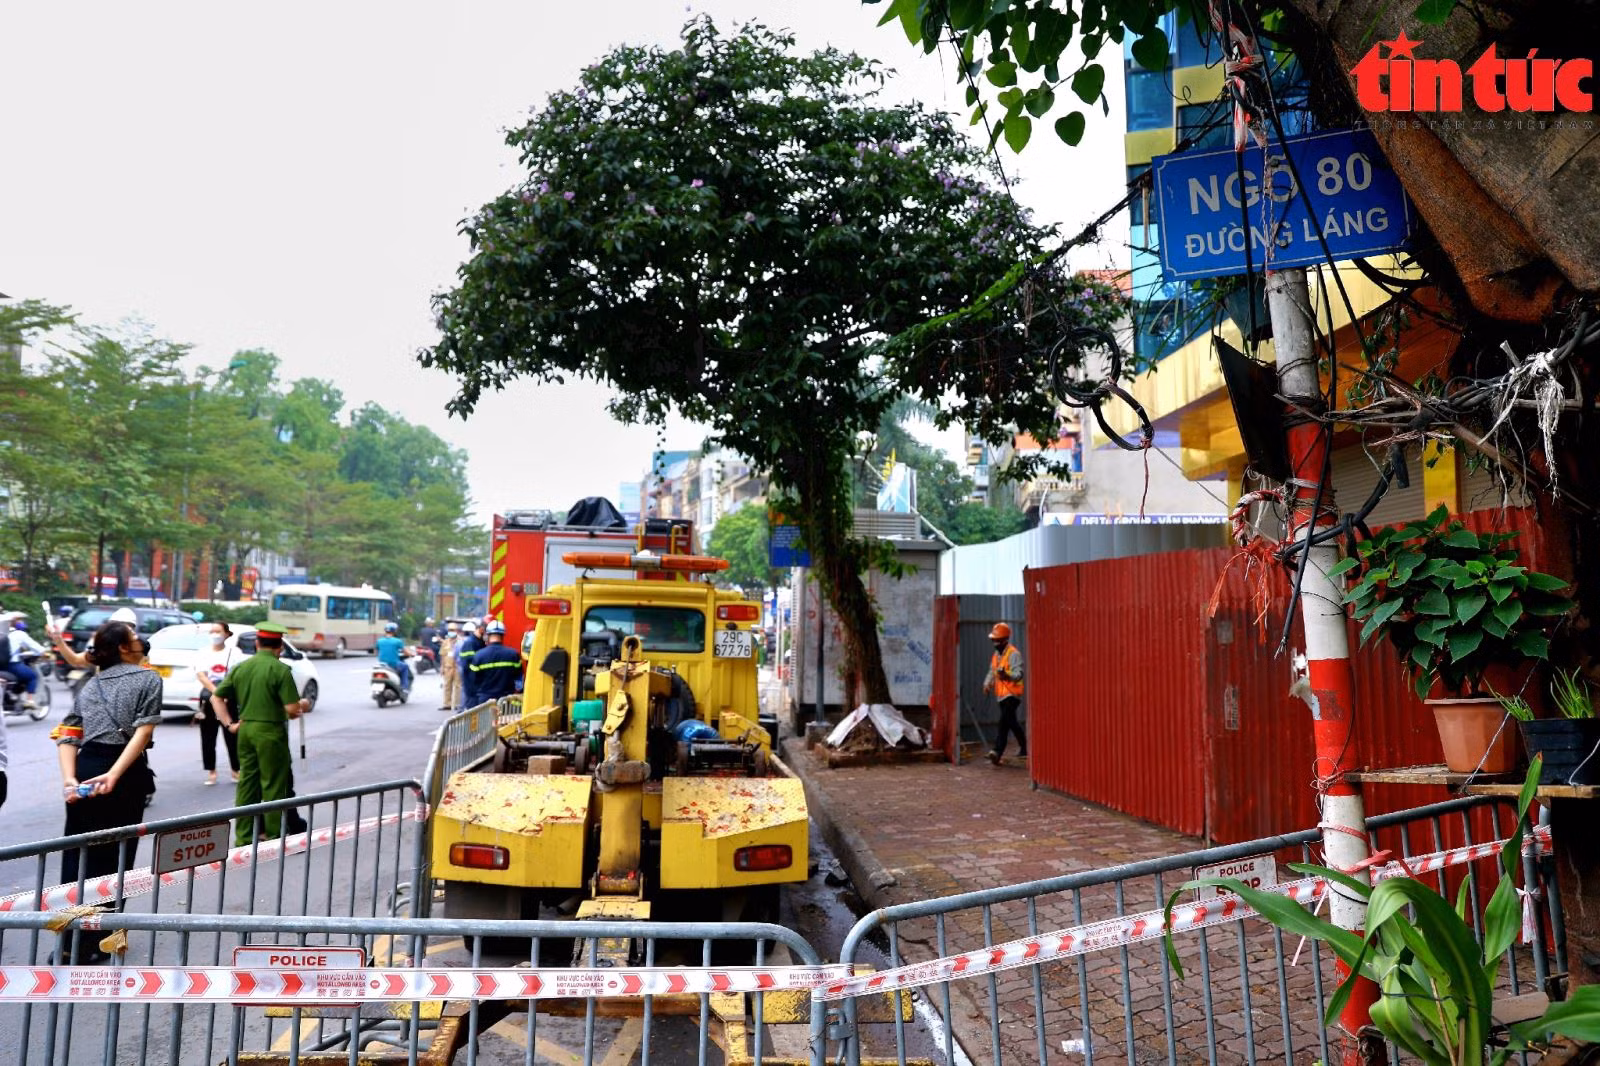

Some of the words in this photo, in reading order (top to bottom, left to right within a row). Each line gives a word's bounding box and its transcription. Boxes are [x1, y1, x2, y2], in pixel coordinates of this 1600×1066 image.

[1188, 155, 1299, 215] NGÕ
[1316, 152, 1372, 195] 80
[1185, 221, 1293, 258] ĐƯỜNG
[1303, 207, 1389, 242] LÁNG
[722, 631, 744, 644] 29C
[714, 644, 751, 657] 677.76
[180, 829, 212, 842] POLICE
[173, 842, 215, 862] STOP
[1219, 862, 1255, 877] POLICE
[270, 955, 327, 966] POLICE
